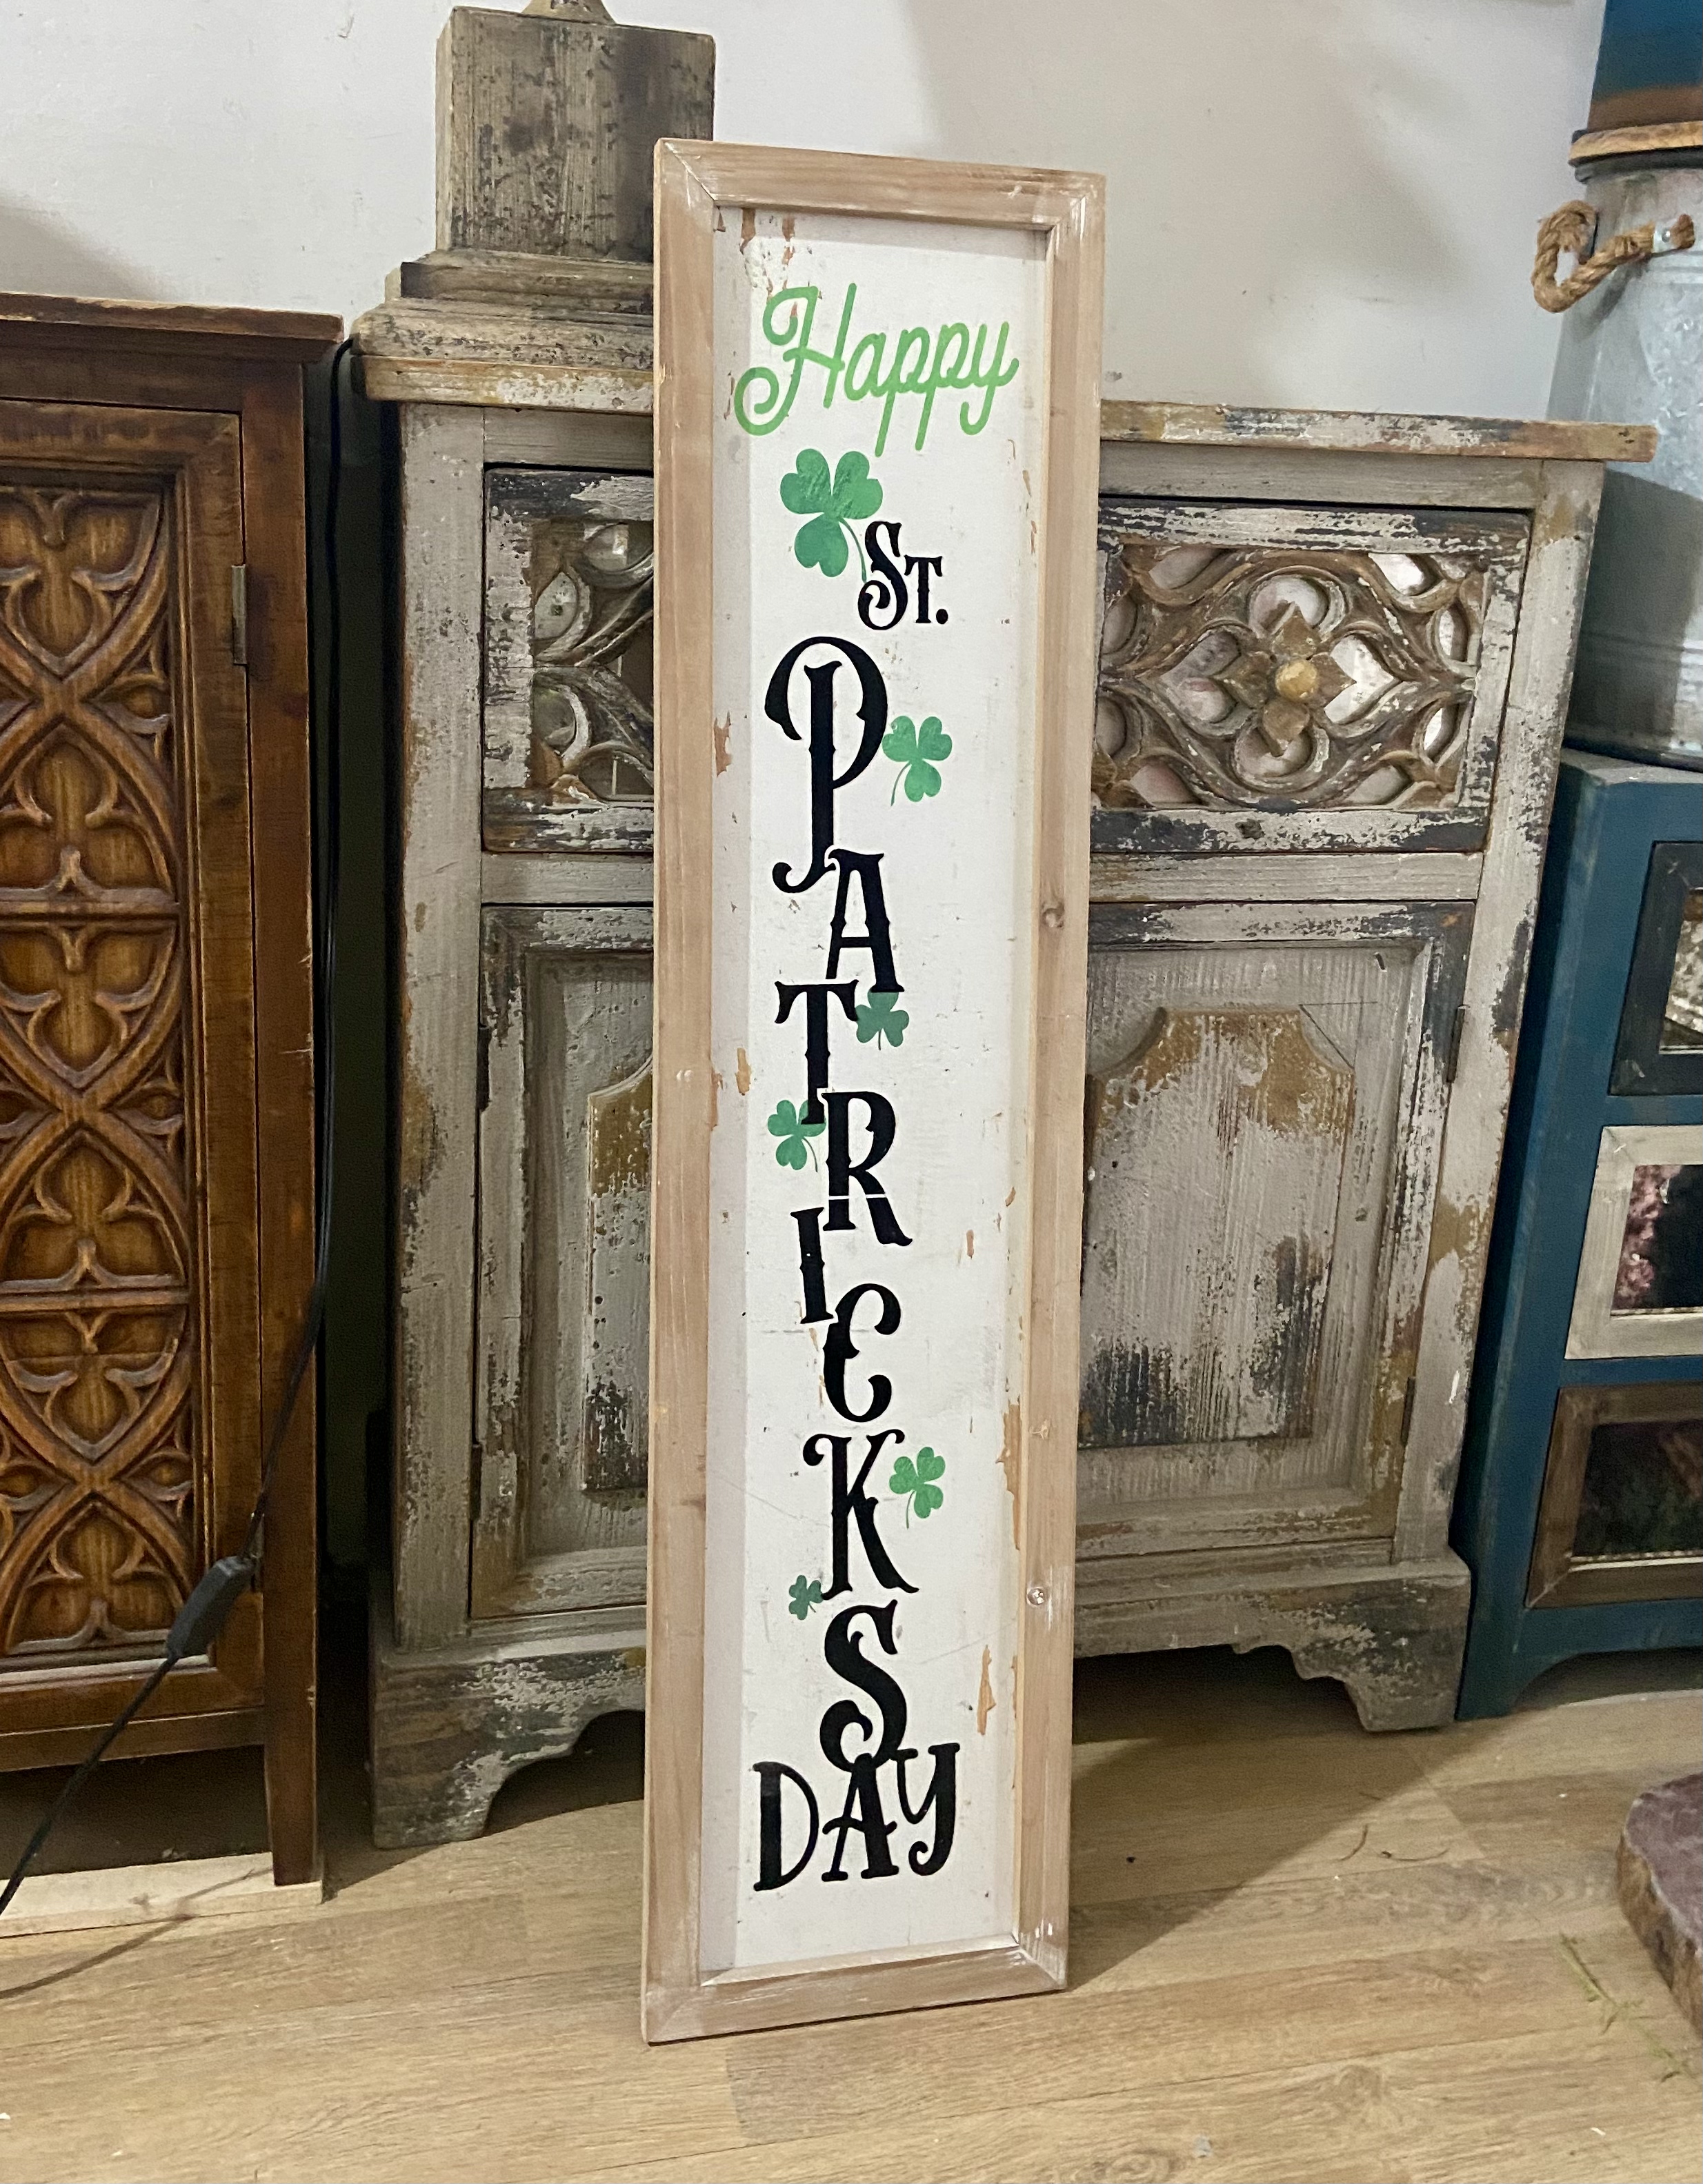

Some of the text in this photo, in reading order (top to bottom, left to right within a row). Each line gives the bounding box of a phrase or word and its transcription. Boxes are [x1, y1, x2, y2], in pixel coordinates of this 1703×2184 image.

[734, 283, 1019, 457] Happy
[764, 636, 919, 1772] PATRICKS
[753, 1743, 960, 1892] DAY
